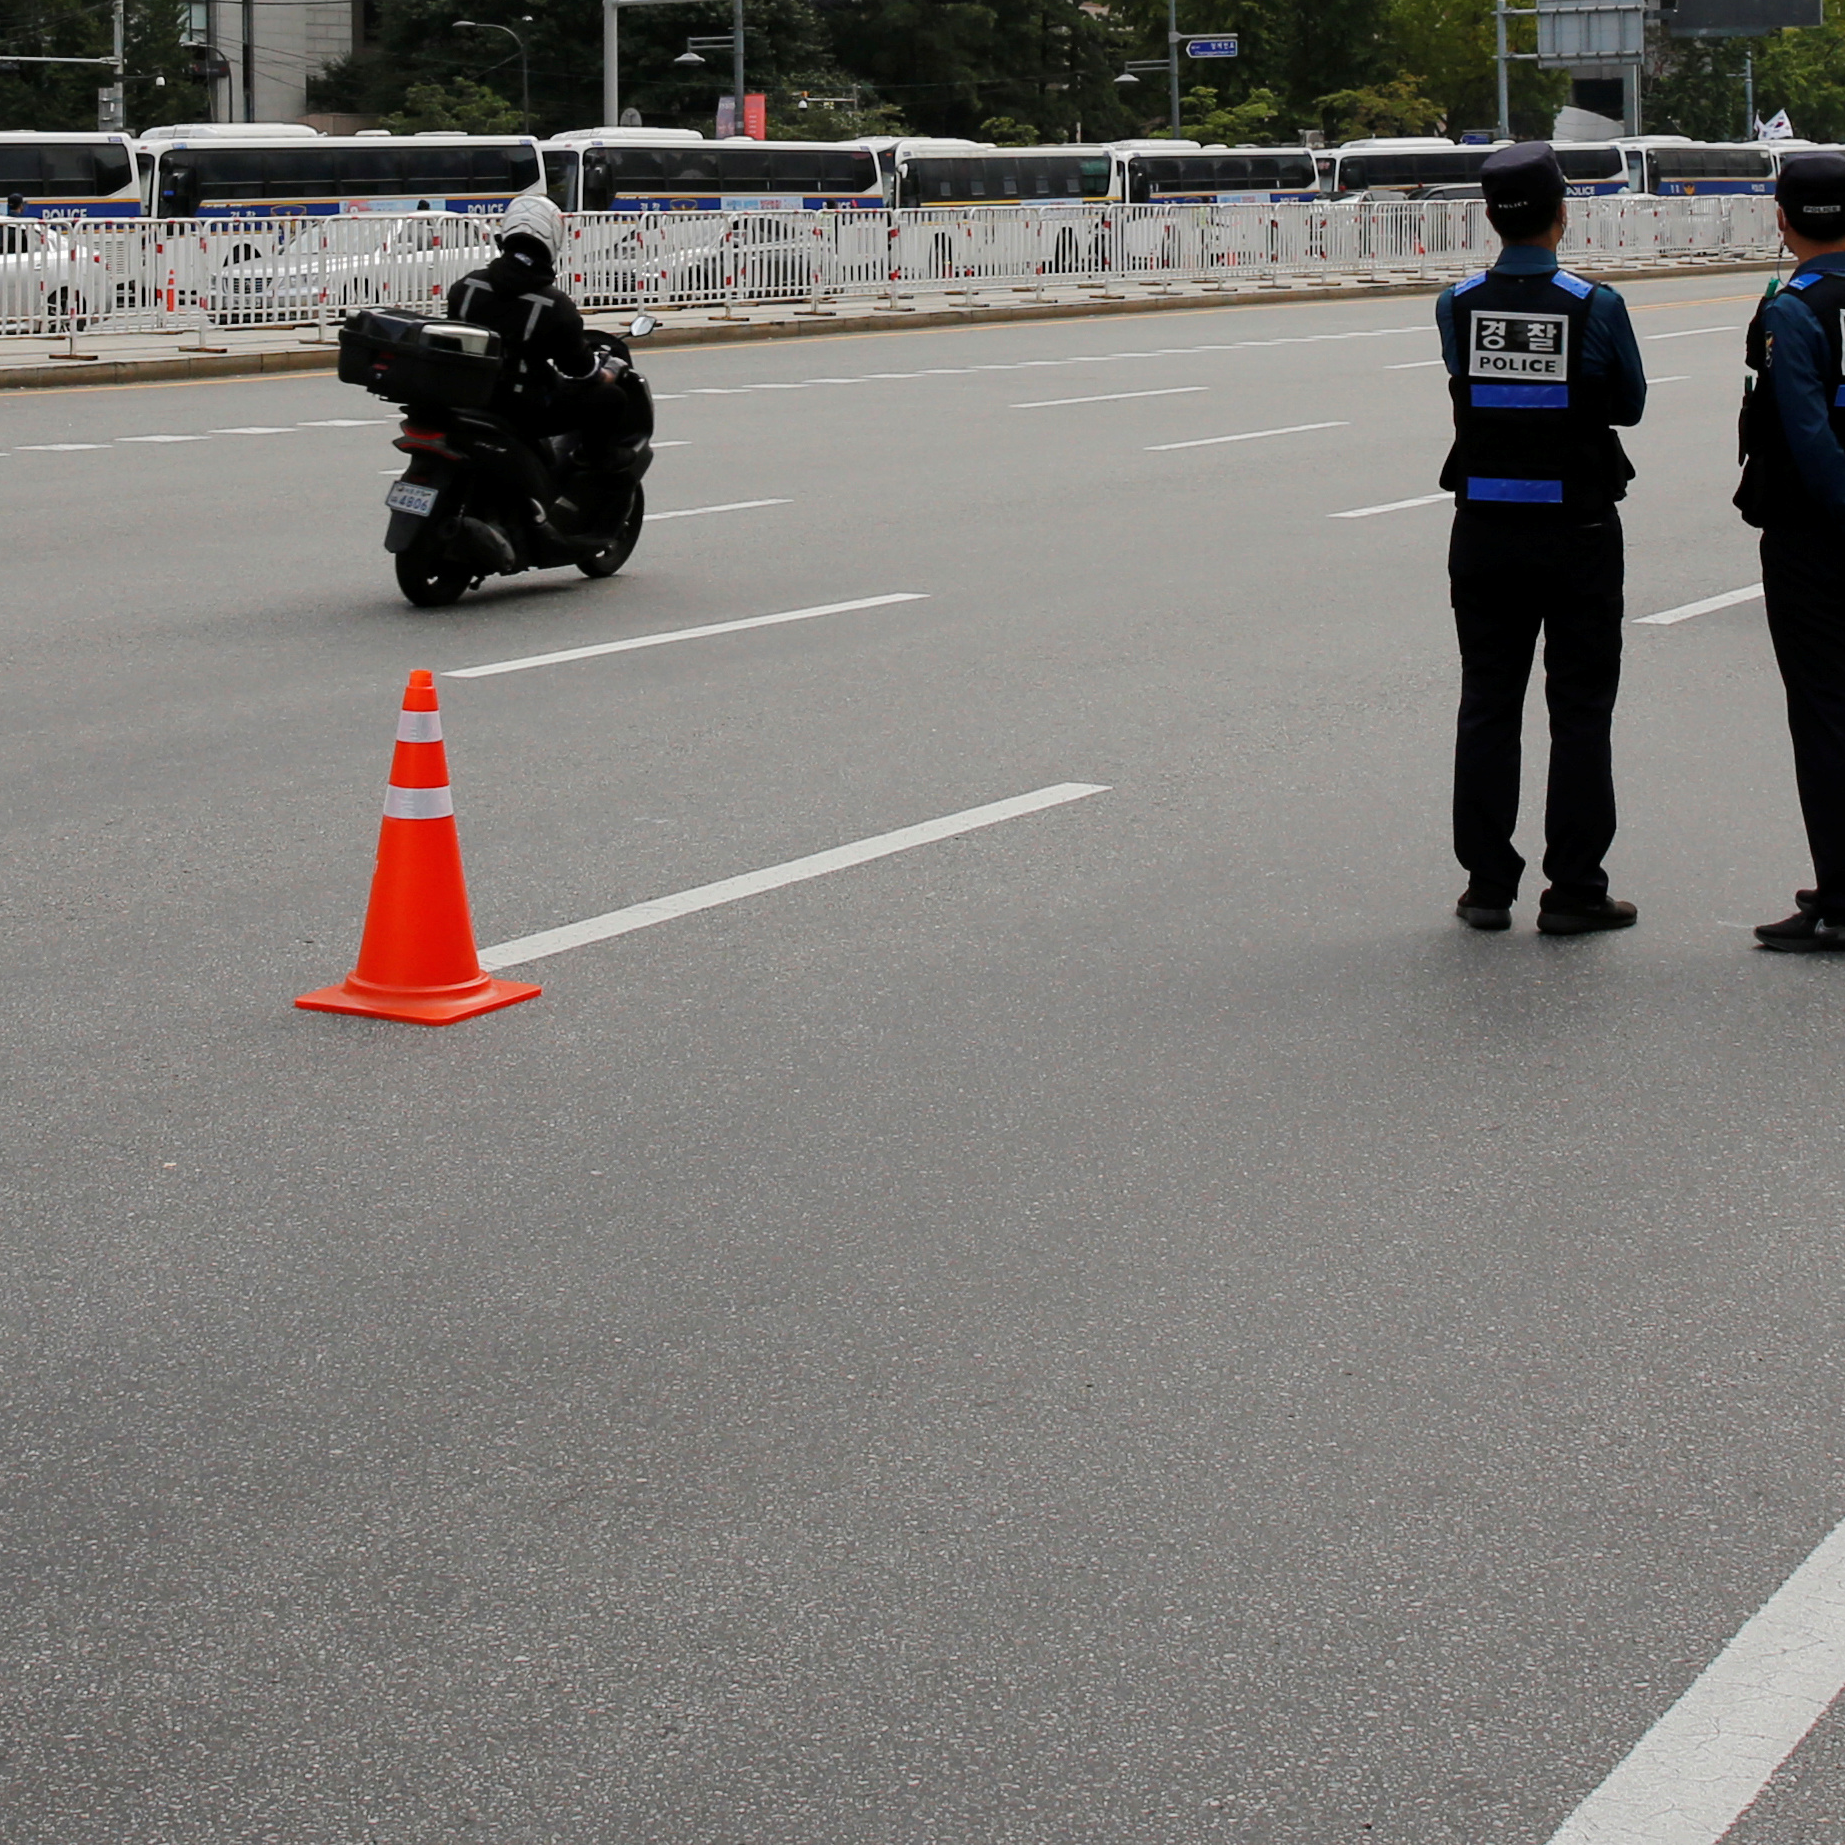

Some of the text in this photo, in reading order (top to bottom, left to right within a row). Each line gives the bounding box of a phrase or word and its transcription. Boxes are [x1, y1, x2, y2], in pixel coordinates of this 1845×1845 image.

[1565, 185, 1595, 196] POLICE
[467, 204, 504, 215] POLICE
[1498, 201, 1528, 209] POLICE
[42, 208, 87, 220] POLICE
[1481, 319, 1557, 351] 경찰
[1478, 355, 1557, 374] POLICE
